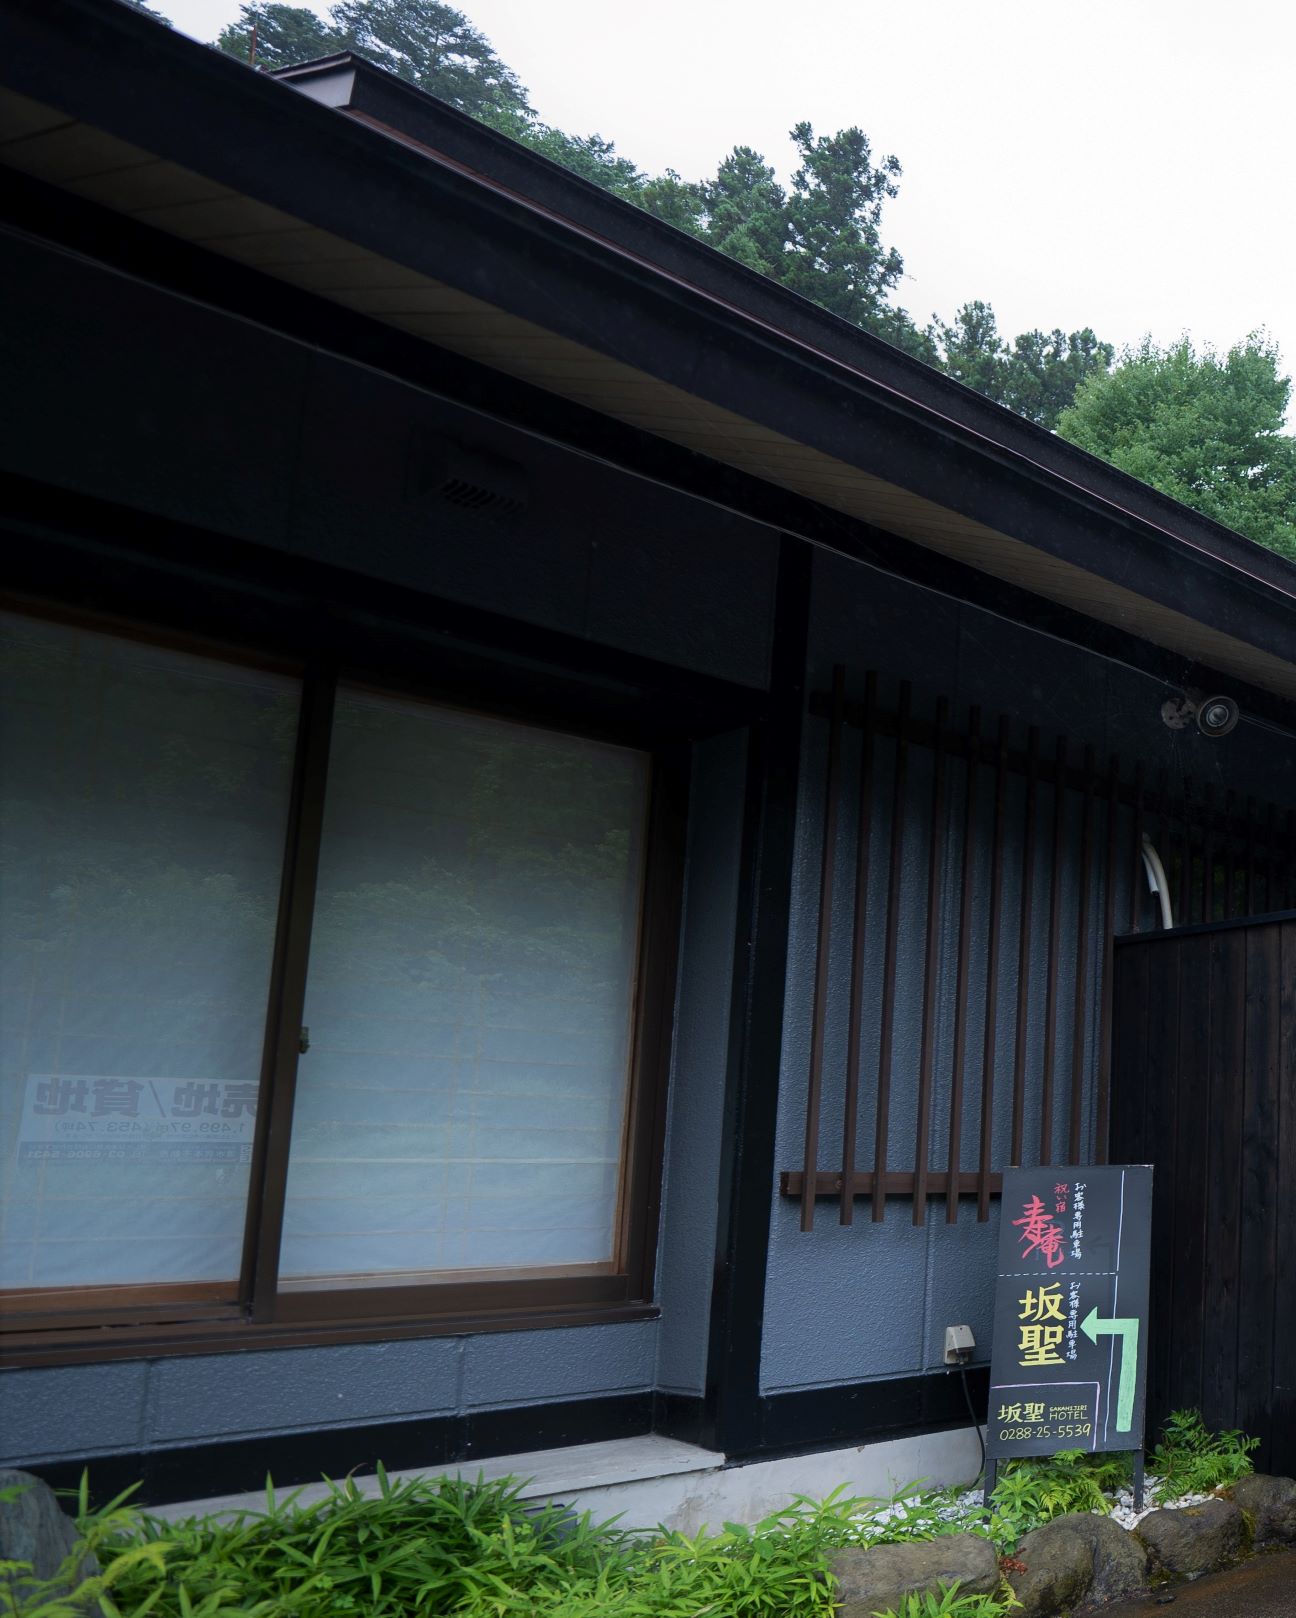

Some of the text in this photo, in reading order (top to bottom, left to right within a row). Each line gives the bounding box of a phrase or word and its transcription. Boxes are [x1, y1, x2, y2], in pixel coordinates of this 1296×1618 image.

[1054, 1182, 1070, 1213] 祝い宿
[1069, 1182, 1087, 1260] お客様専用駐車場
[1018, 1281, 1068, 1367] 坂聖
[1065, 1281, 1081, 1360] お客様専用駐車場
[997, 1402, 1046, 1424] 坂聖
[1049, 1404, 1088, 1412] SAKAHIJIRI
[1049, 1411, 1089, 1421] HOTEL
[1000, 1423, 1091, 1441] 0288-25-5539
